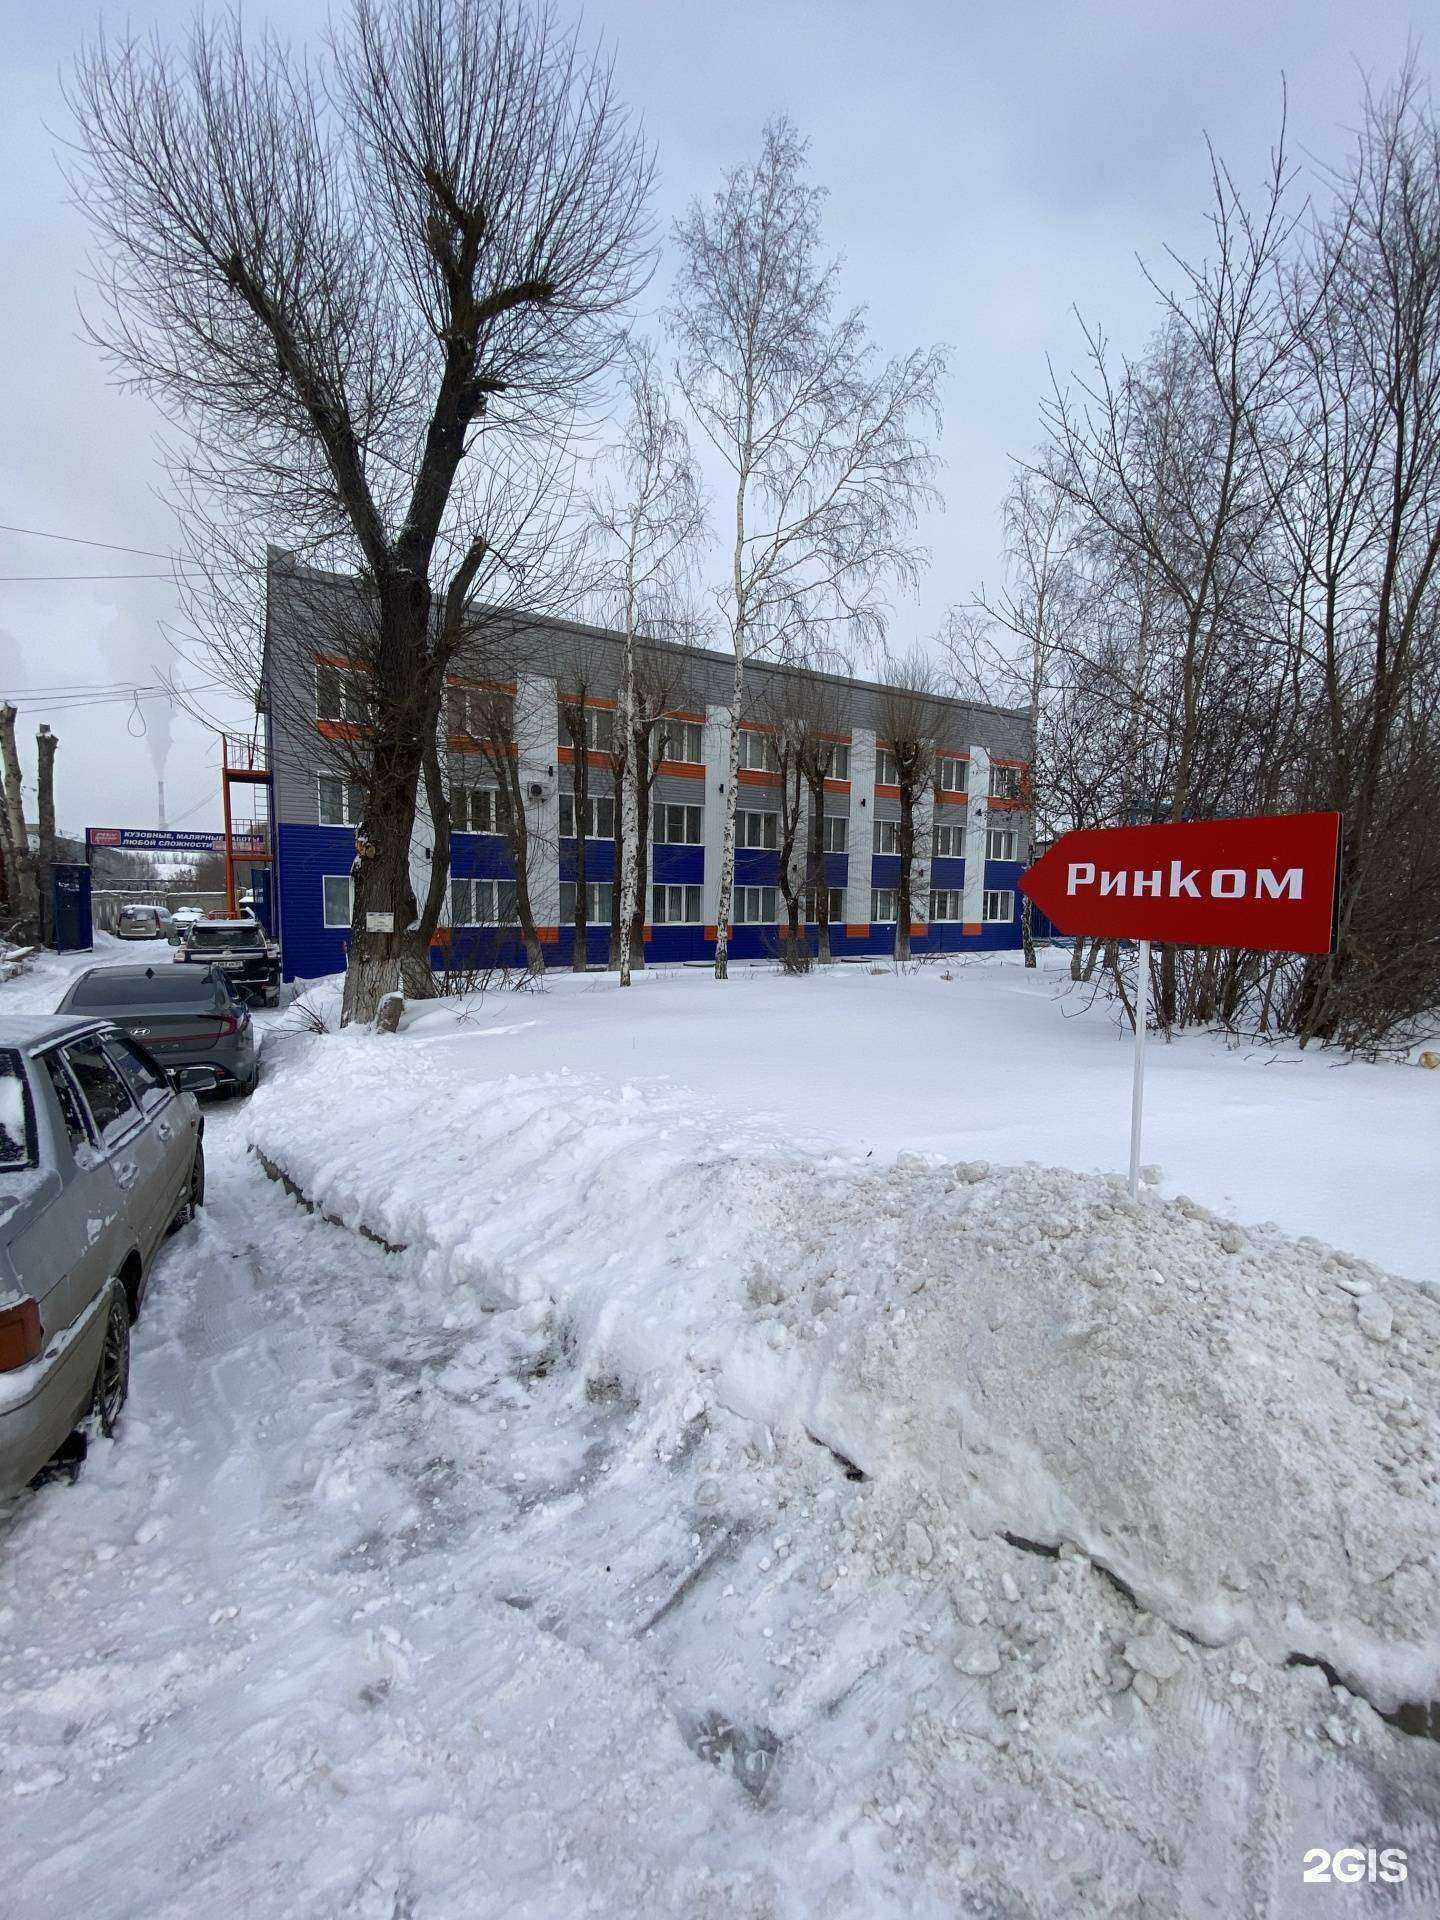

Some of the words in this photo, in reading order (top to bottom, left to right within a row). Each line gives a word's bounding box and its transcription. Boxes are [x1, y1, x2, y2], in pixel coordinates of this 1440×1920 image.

[124, 831, 174, 839] КУЗОВНЫЕ,
[176, 833, 224, 841] МАЛЯРНЫЕ
[158, 840, 212, 848] СЛОЖНОСТИ
[1066, 860, 1304, 900] Ринком
